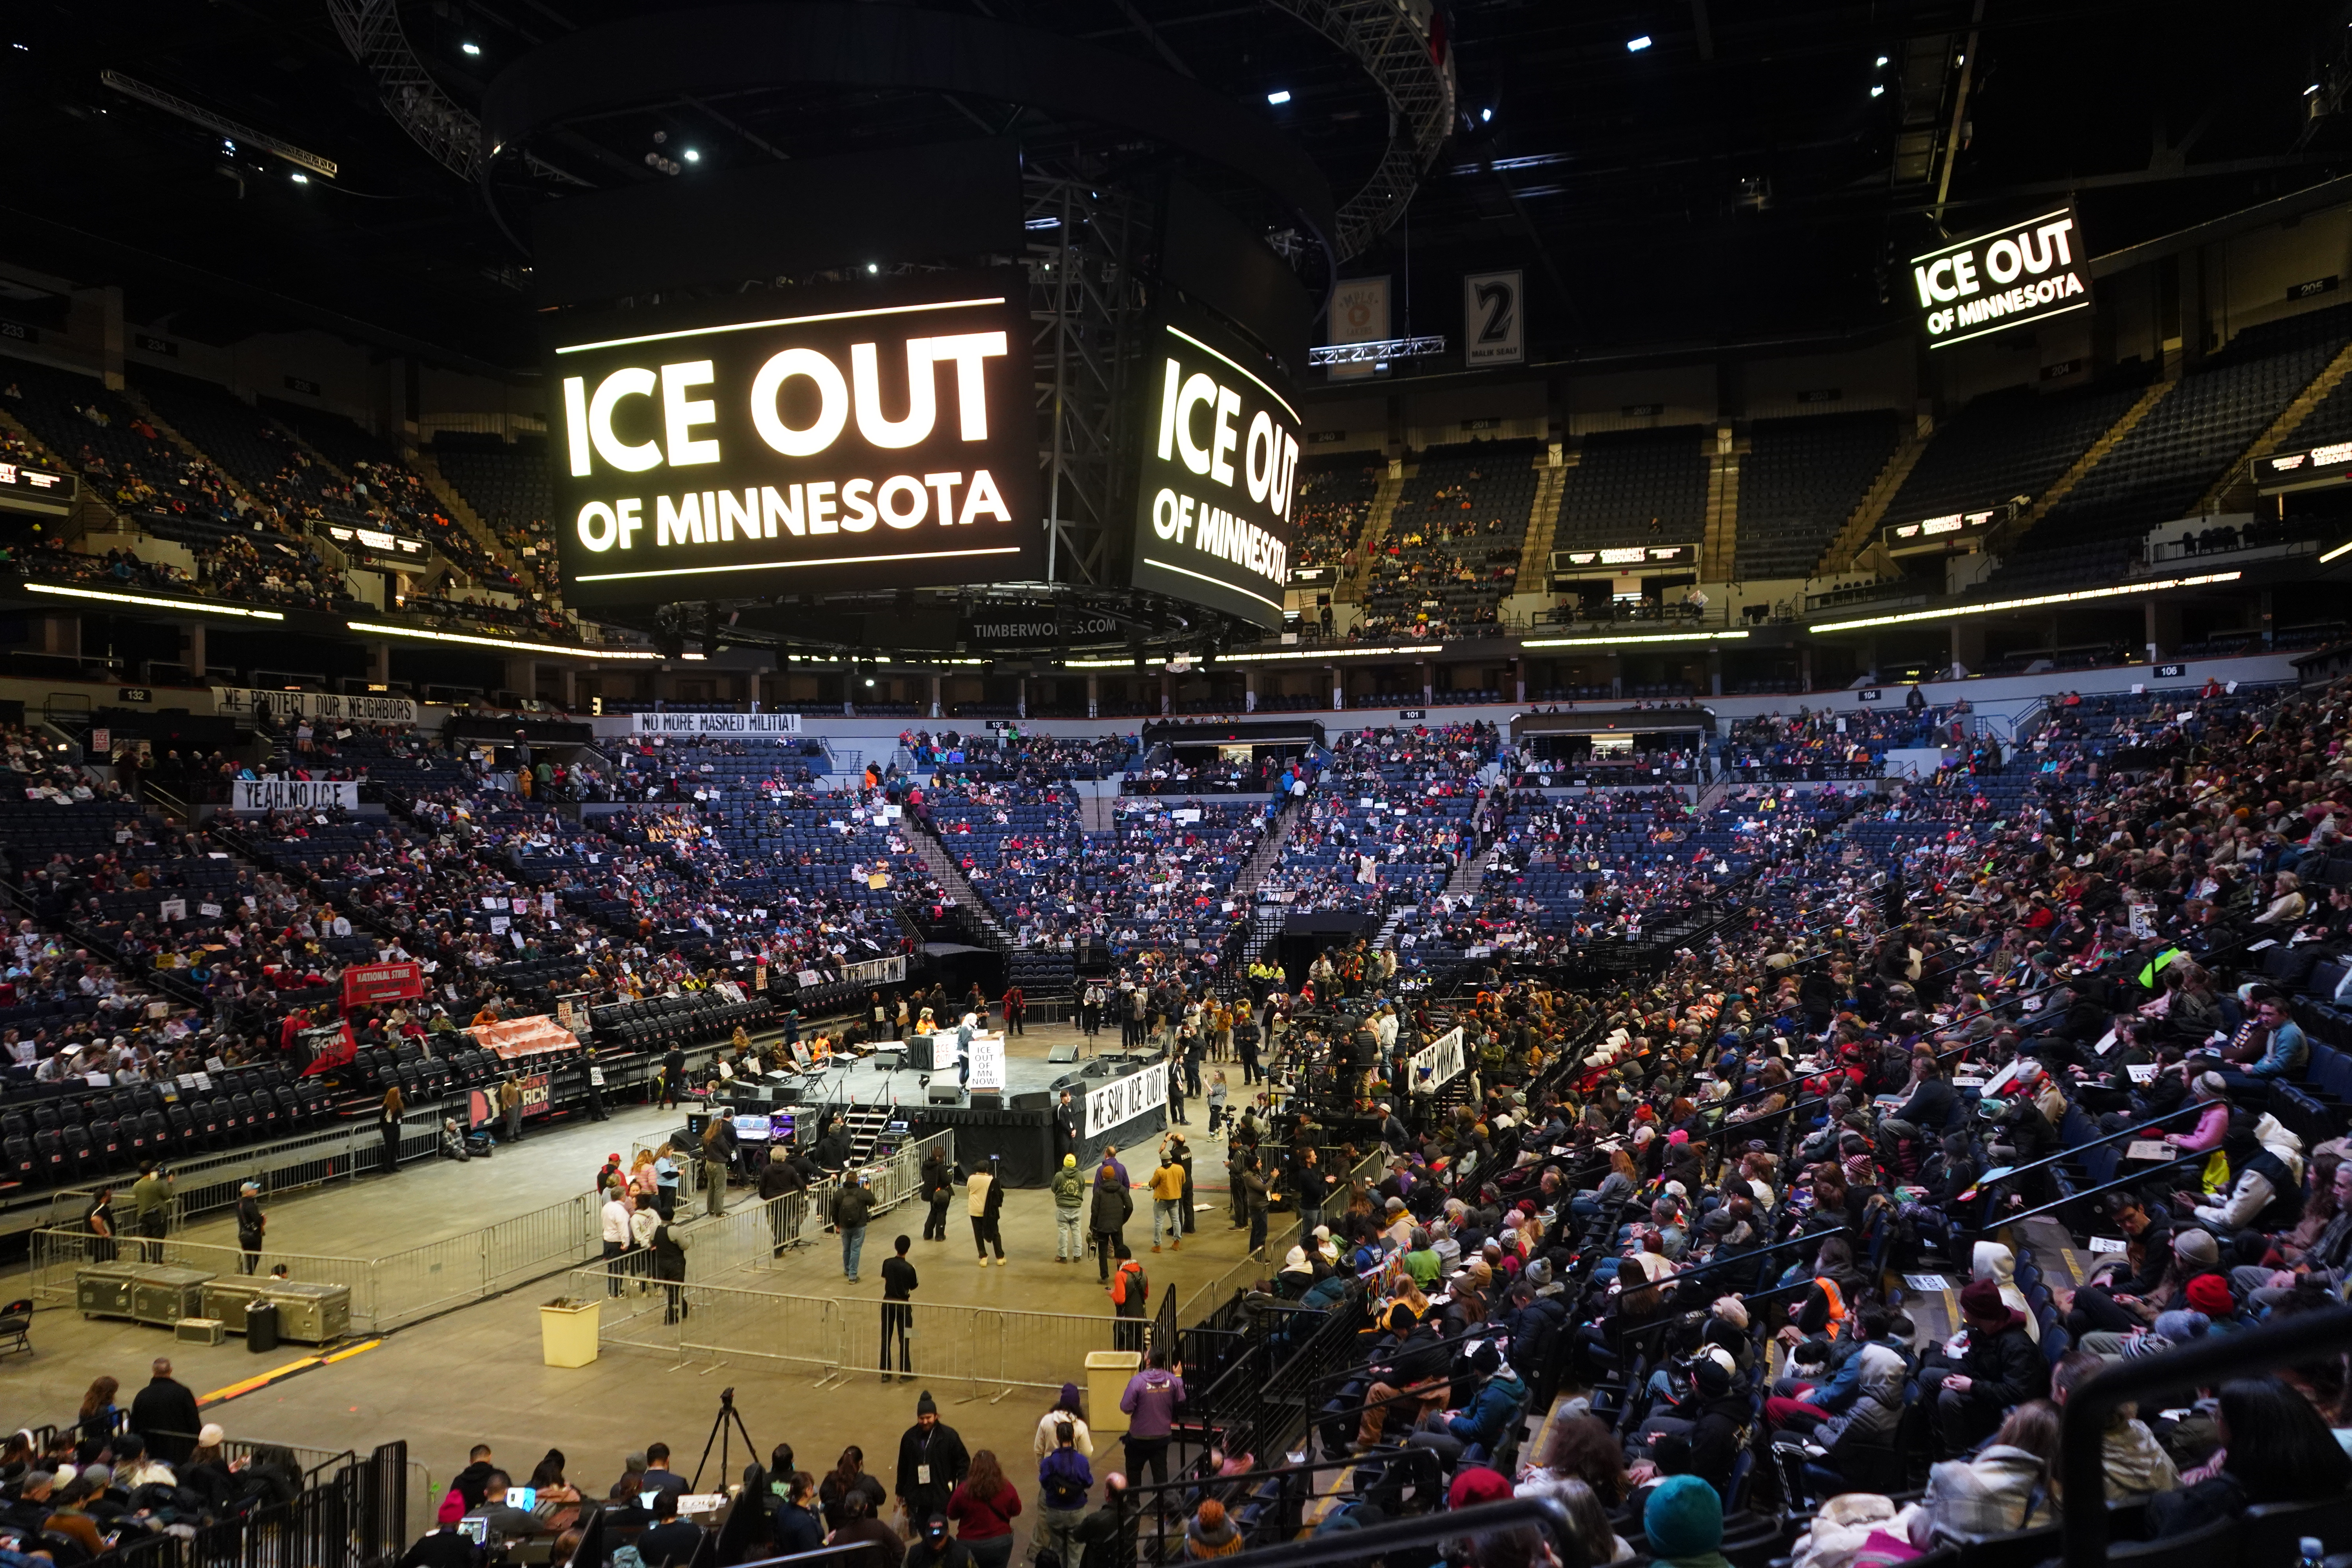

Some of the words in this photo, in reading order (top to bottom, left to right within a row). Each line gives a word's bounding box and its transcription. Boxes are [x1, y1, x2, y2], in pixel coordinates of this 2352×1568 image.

[1915, 250, 1980, 307] ICE
[1986, 218, 2073, 283] OUT
[2301, 280, 2323, 297] 205
[1928, 308, 1954, 334] OF
[1958, 272, 2084, 328] MINNESOTA
[1475, 281, 1514, 344] 2
[1, 323, 24, 338] 233
[148, 339, 166, 352] 234
[1496, 347, 1517, 355] SEALY
[2053, 364, 2069, 376] 204
[564, 360, 720, 476] ICE
[751, 331, 1007, 456] OUT
[1633, 406, 1651, 416] 202
[1158, 358, 1241, 487] ICE
[1246, 411, 1299, 523] OUT
[578, 498, 642, 552] OF
[657, 470, 1011, 546] MINNESOTA
[1922, 514, 1962, 528] COMMUNITY
[1924, 521, 1962, 535] RESOURCES
[356, 529, 394, 543] COMMUNITY
[1153, 488, 1194, 543] OF
[1196, 503, 1286, 587] MINNESOTA
[1600, 548, 1645, 557] COMMUNITY
[1602, 554, 1645, 564] RESOURCES
[974, 619, 1116, 637] TIMBERWOLS.COM
[2161, 666, 2177, 676] 106
[128, 690, 144, 700] 132
[223, 689, 240, 711] WE
[250, 691, 305, 715] PROTECT
[316, 695, 340, 716] OUR
[347, 697, 411, 720] NEIGHBORS
[642, 714, 658, 731] NO
[663, 714, 694, 731] MORE
[700, 714, 744, 731] MASKED
[356, 971, 390, 983] NATIONAL
[391, 968, 410, 980] STRIKE
[862, 961, 875, 987] OUT
[559, 1008, 570, 1017] ICE
[321, 1033, 347, 1049] CWA
[936, 1044, 949, 1053] ICE
[936, 1054, 950, 1063] OUT!
[523, 1085, 549, 1106] RCH
[1092, 1092, 1104, 1131] WE
[1108, 1083, 1122, 1124] SAY
[1128, 1076, 1142, 1115] ICE
[1147, 1065, 1167, 1106] OUT!
[521, 1102, 549, 1117] ESOTA
